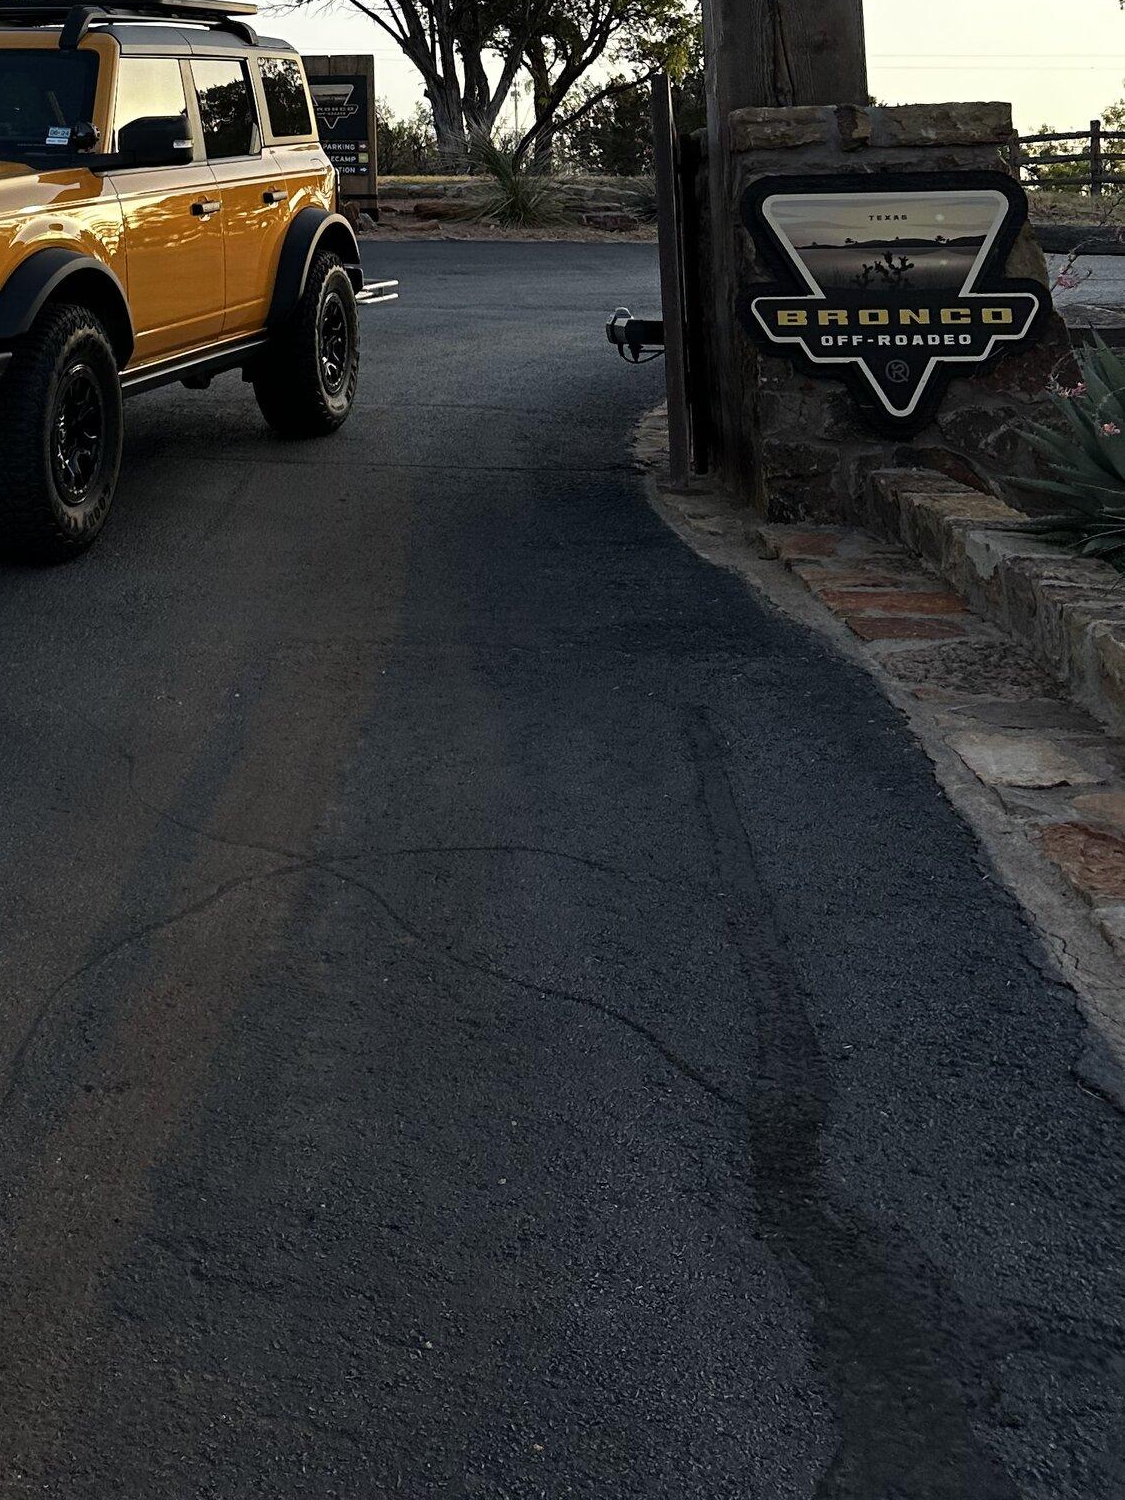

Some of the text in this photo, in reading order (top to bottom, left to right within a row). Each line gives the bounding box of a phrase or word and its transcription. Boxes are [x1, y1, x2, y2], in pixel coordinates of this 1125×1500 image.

[338, 166, 355, 174] TION
[777, 308, 1013, 326] BRONCO
[820, 334, 972, 346] OFF-ROADEO
